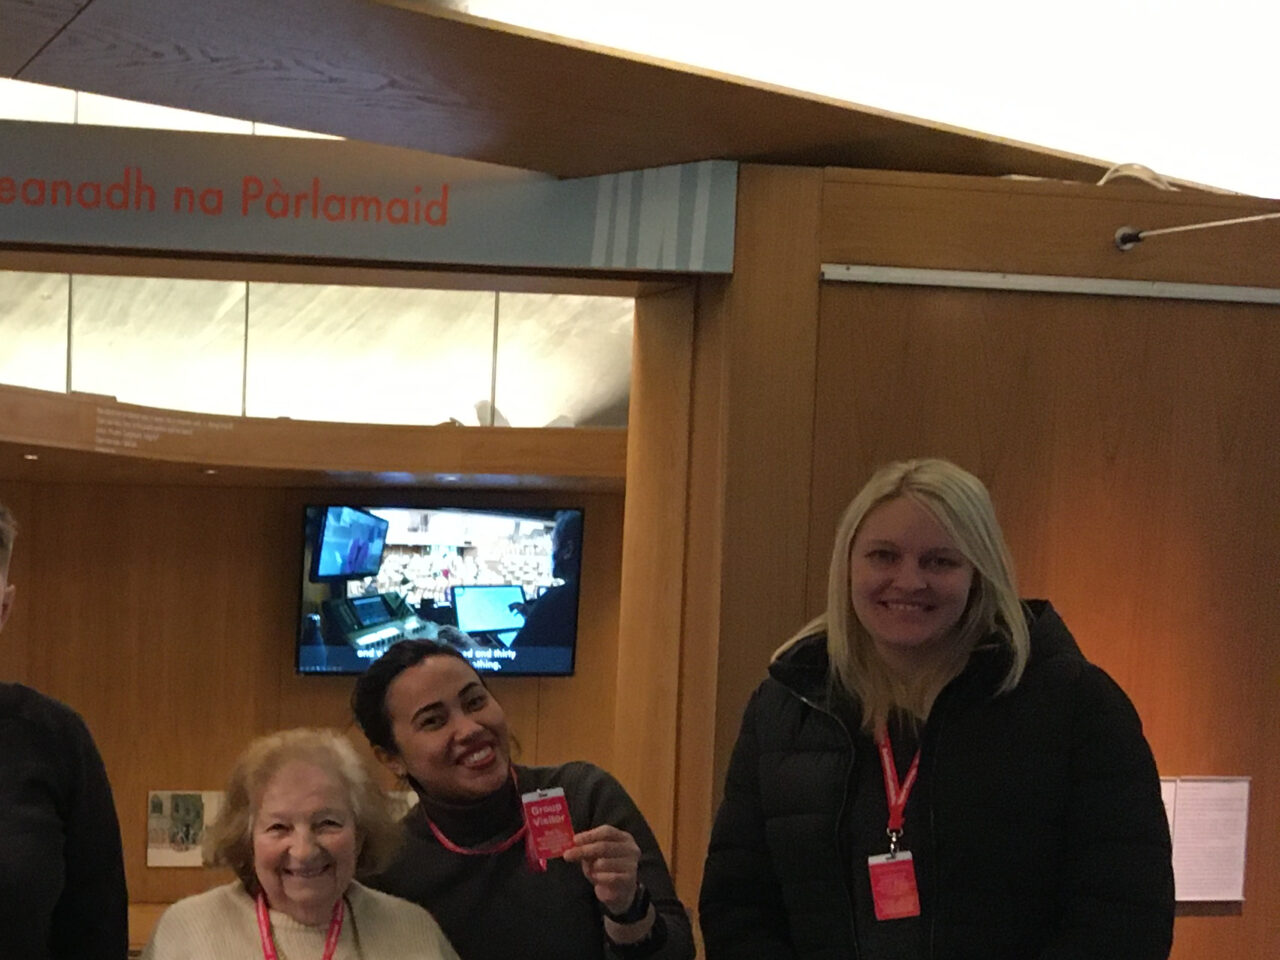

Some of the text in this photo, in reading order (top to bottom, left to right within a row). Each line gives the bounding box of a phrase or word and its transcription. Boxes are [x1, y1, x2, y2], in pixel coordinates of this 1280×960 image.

[173, 184, 224, 217] na
[240, 175, 448, 228] Pàrlamaid
[474, 648, 492, 659] and
[493, 648, 517, 661] thirty
